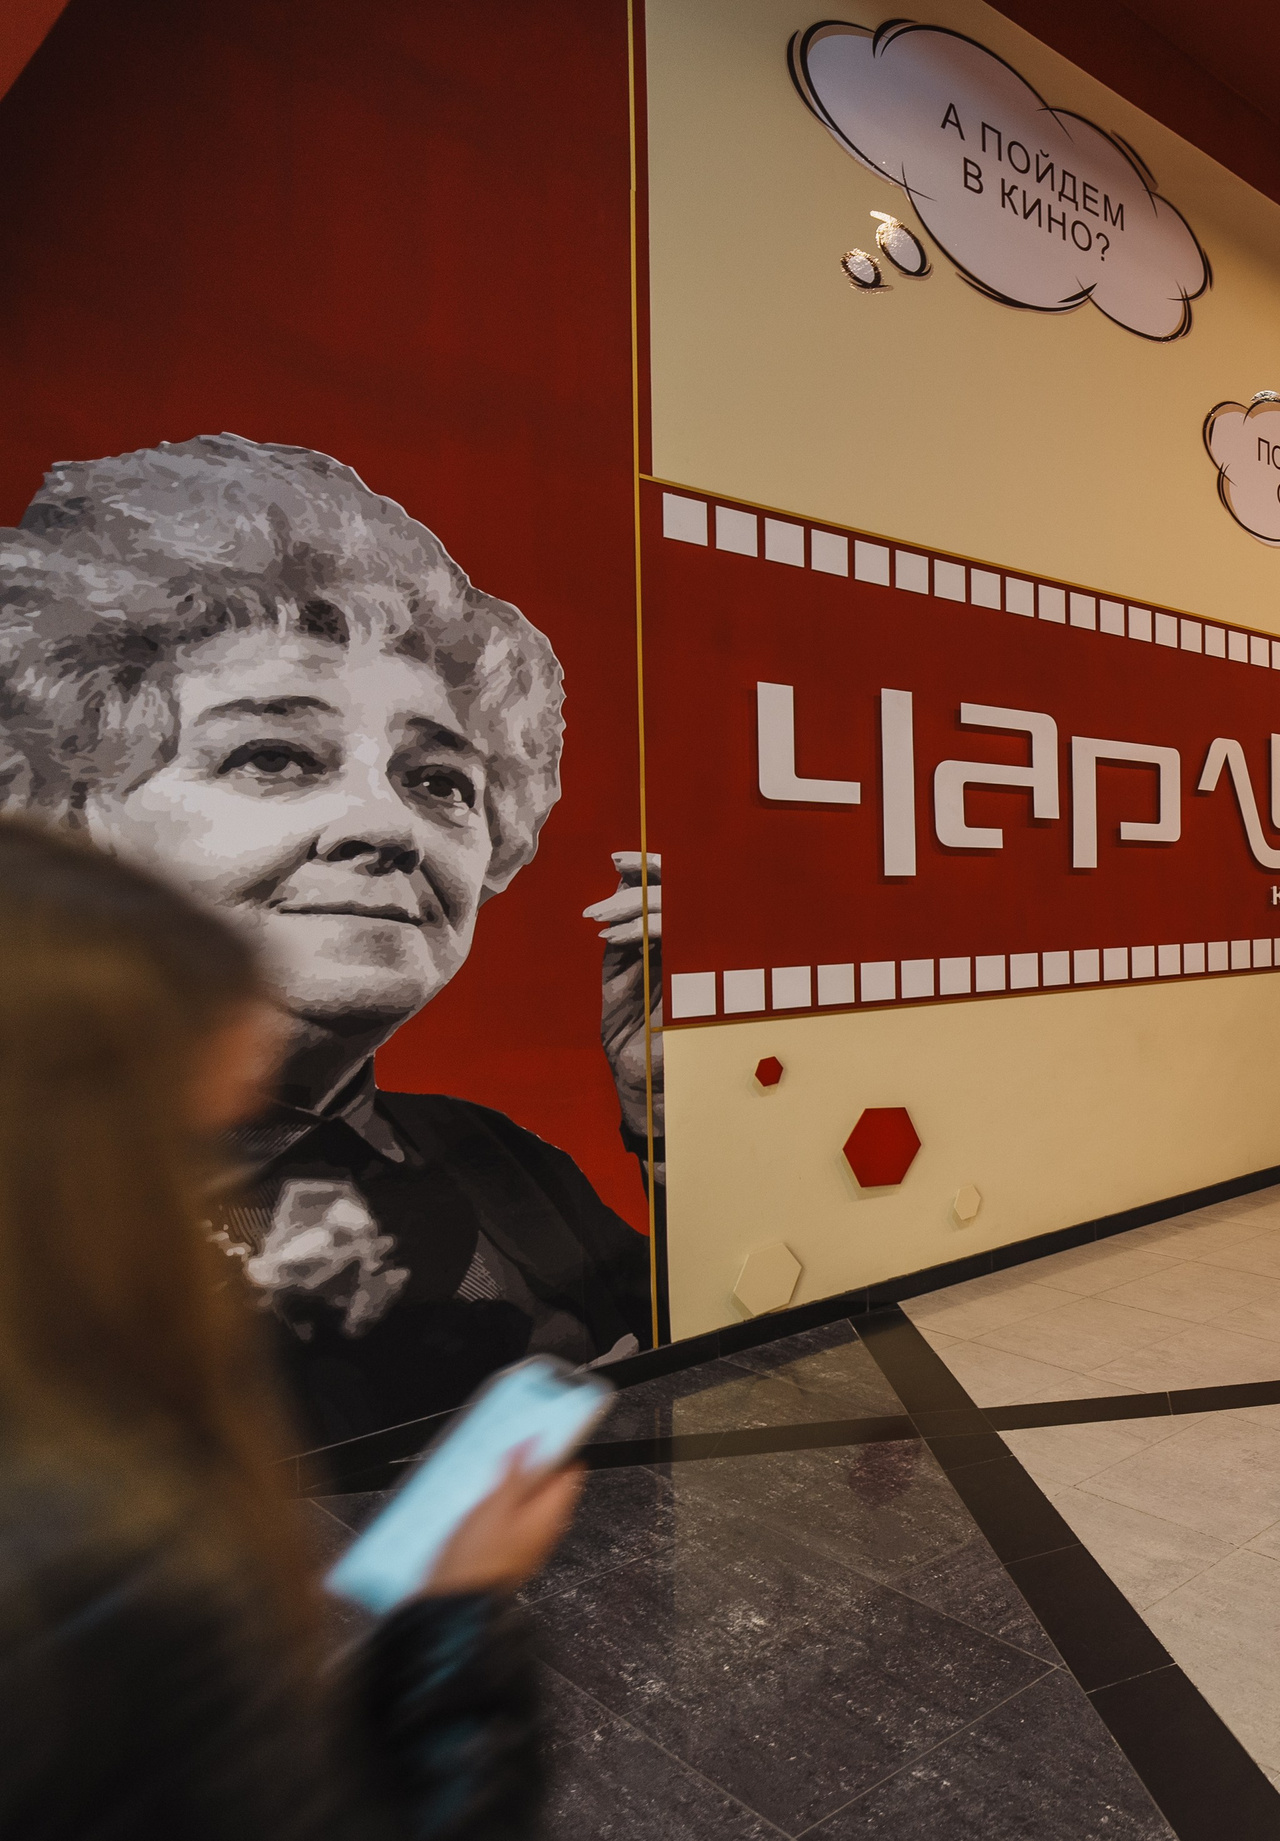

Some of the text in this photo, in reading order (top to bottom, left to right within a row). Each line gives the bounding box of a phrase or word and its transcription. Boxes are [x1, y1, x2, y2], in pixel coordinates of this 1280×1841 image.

[940, 102, 1125, 232] А ПОЙДЕМ
[963, 156, 1110, 262] В КИНО?
